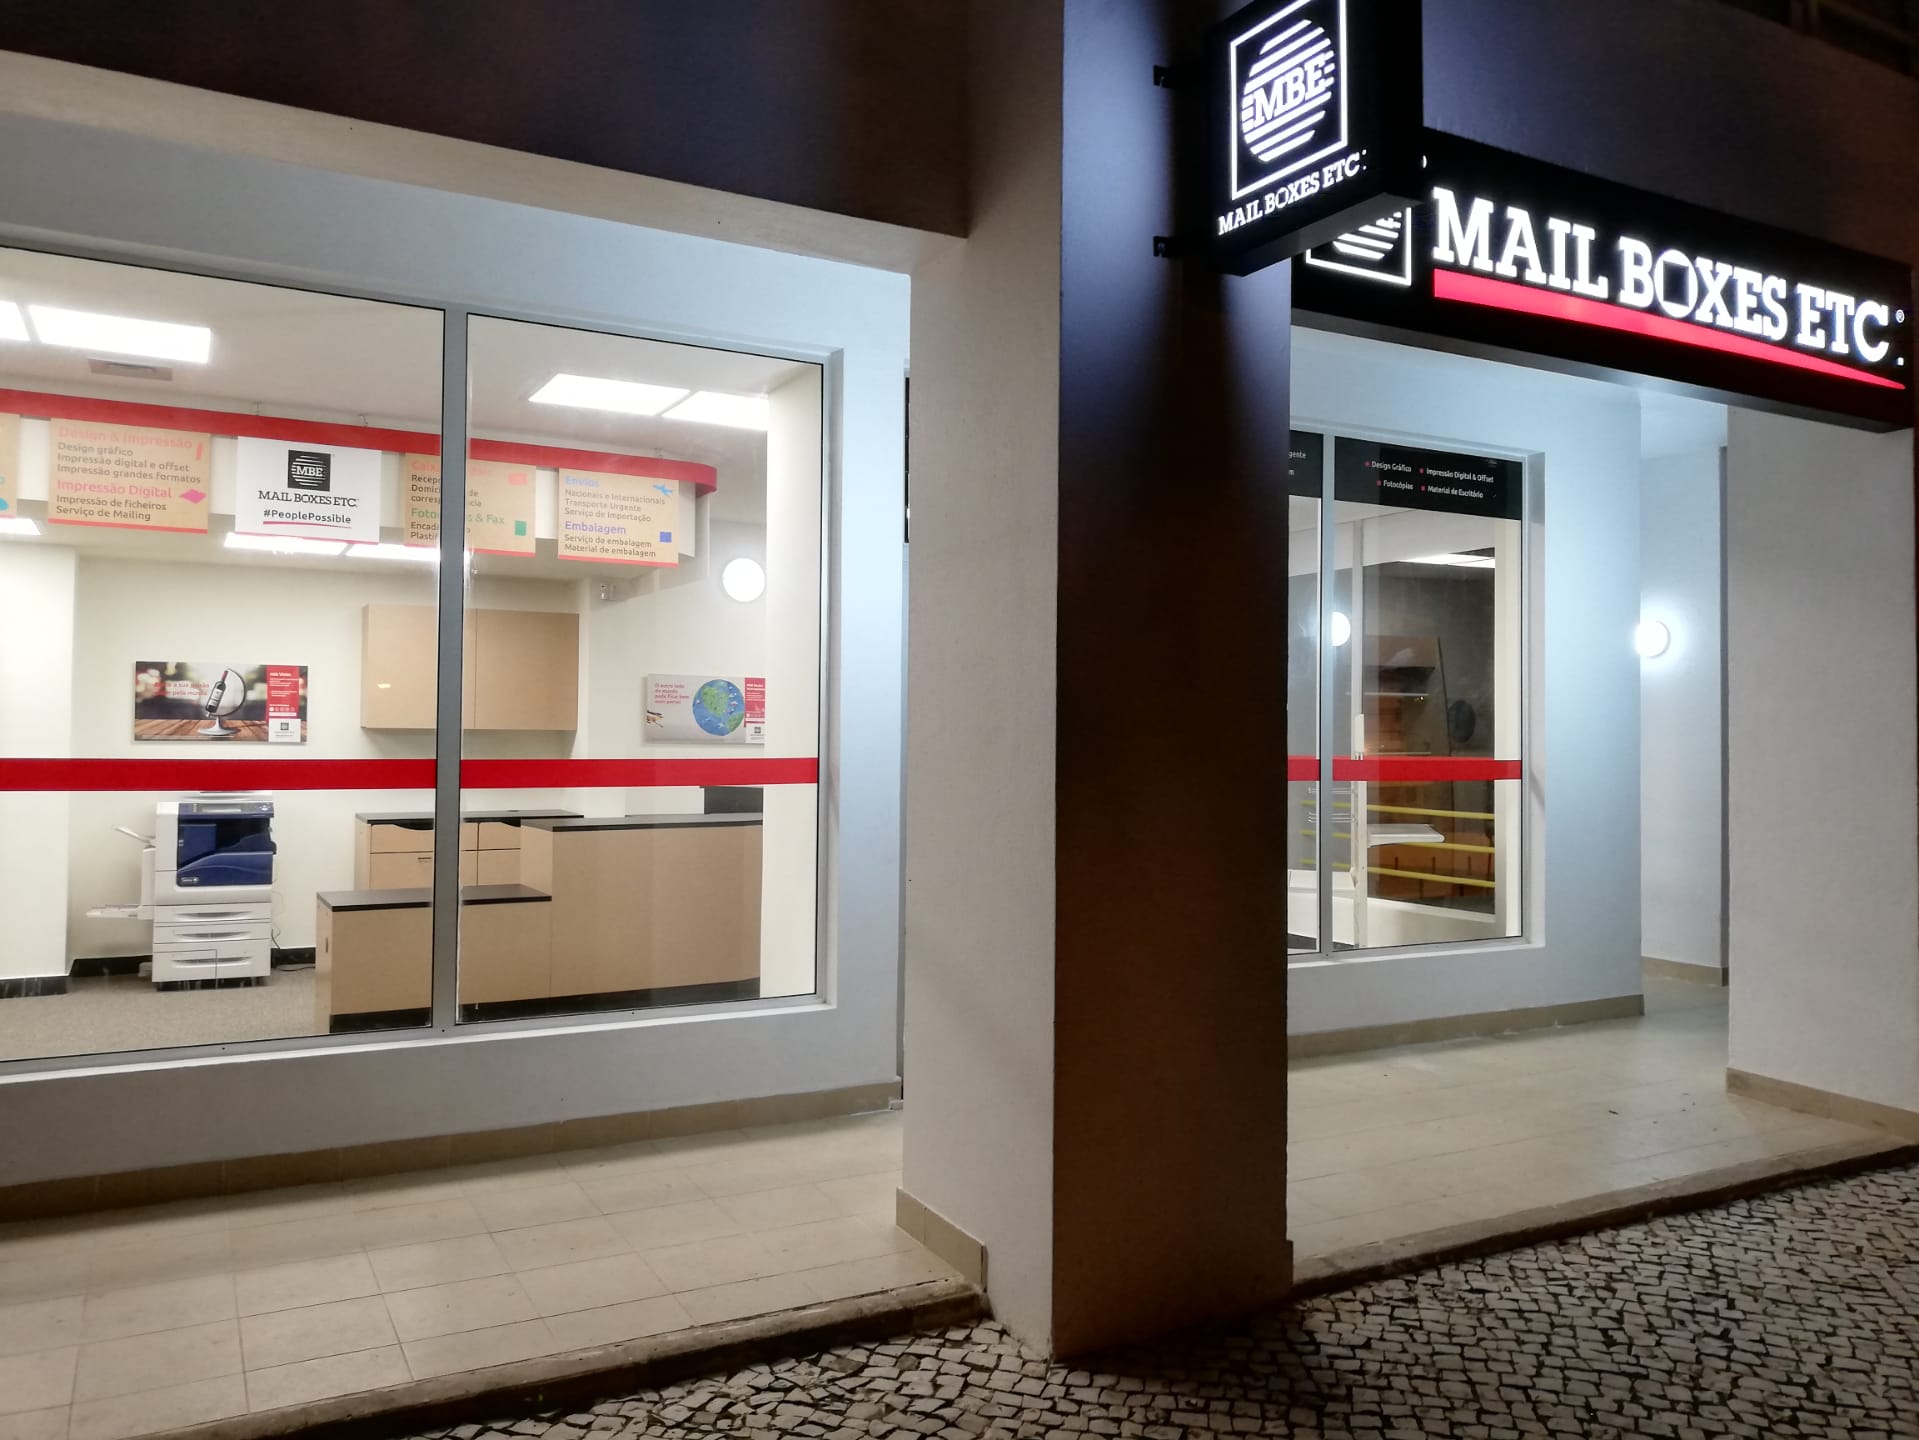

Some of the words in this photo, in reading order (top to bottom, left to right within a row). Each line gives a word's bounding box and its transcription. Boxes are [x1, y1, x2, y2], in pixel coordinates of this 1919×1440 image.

[1252, 53, 1325, 127] MBE
[1218, 203, 1263, 236] MAIL
[1264, 172, 1320, 214] BOXES
[1433, 187, 1608, 299] MAIL
[1619, 236, 1787, 340] BOXES
[58, 427, 106, 442] Design
[124, 432, 192, 450] Impressão
[58, 442, 94, 454] Design
[97, 444, 133, 456] gráfico
[1289, 451, 1306, 459] gente
[58, 453, 111, 466] Impressão
[115, 458, 146, 468] digital
[158, 461, 190, 472] offset
[1372, 461, 1390, 471] Design
[1392, 463, 1411, 473] Gráfico
[58, 464, 110, 476] Impressão
[113, 468, 153, 480] grandes
[156, 472, 201, 483] formatos
[296, 466, 324, 477] MBE
[412, 474, 440, 484] Recep
[1426, 467, 1453, 479] Impressão
[1454, 471, 1471, 482] Digital
[1477, 474, 1494, 483] Offset
[56, 480, 125, 495] Impressão
[129, 485, 172, 499] Digital
[1383, 479, 1413, 491] Fotocópias
[1428, 485, 1450, 494] Material
[1450, 487, 1458, 495] de
[1459, 488, 1483, 498] Escritório
[56, 495, 107, 508] Impressão
[110, 498, 121, 507] de
[124, 499, 167, 511] ficheiros
[258, 490, 292, 502] MAIL
[294, 494, 332, 505] BOXES
[565, 488, 602, 499] Nacionais
[611, 493, 665, 505] Internacionais
[56, 505, 95, 518] Serviço
[97, 508, 110, 517] de
[113, 511, 151, 521] Mailing
[565, 499, 607, 509] Transporte
[610, 503, 641, 512] Urgente
[263, 509, 351, 524] #PeoplePossible
[487, 514, 505, 524] Fax
[565, 507, 593, 518] Serviço
[608, 511, 651, 522] Importação
[565, 521, 626, 535] Embalagem
[564, 534, 594, 544] Serviço
[607, 538, 652, 548] embalagem
[564, 543, 598, 553] Material
[600, 546, 609, 554] de
[611, 547, 656, 558] embalagem
